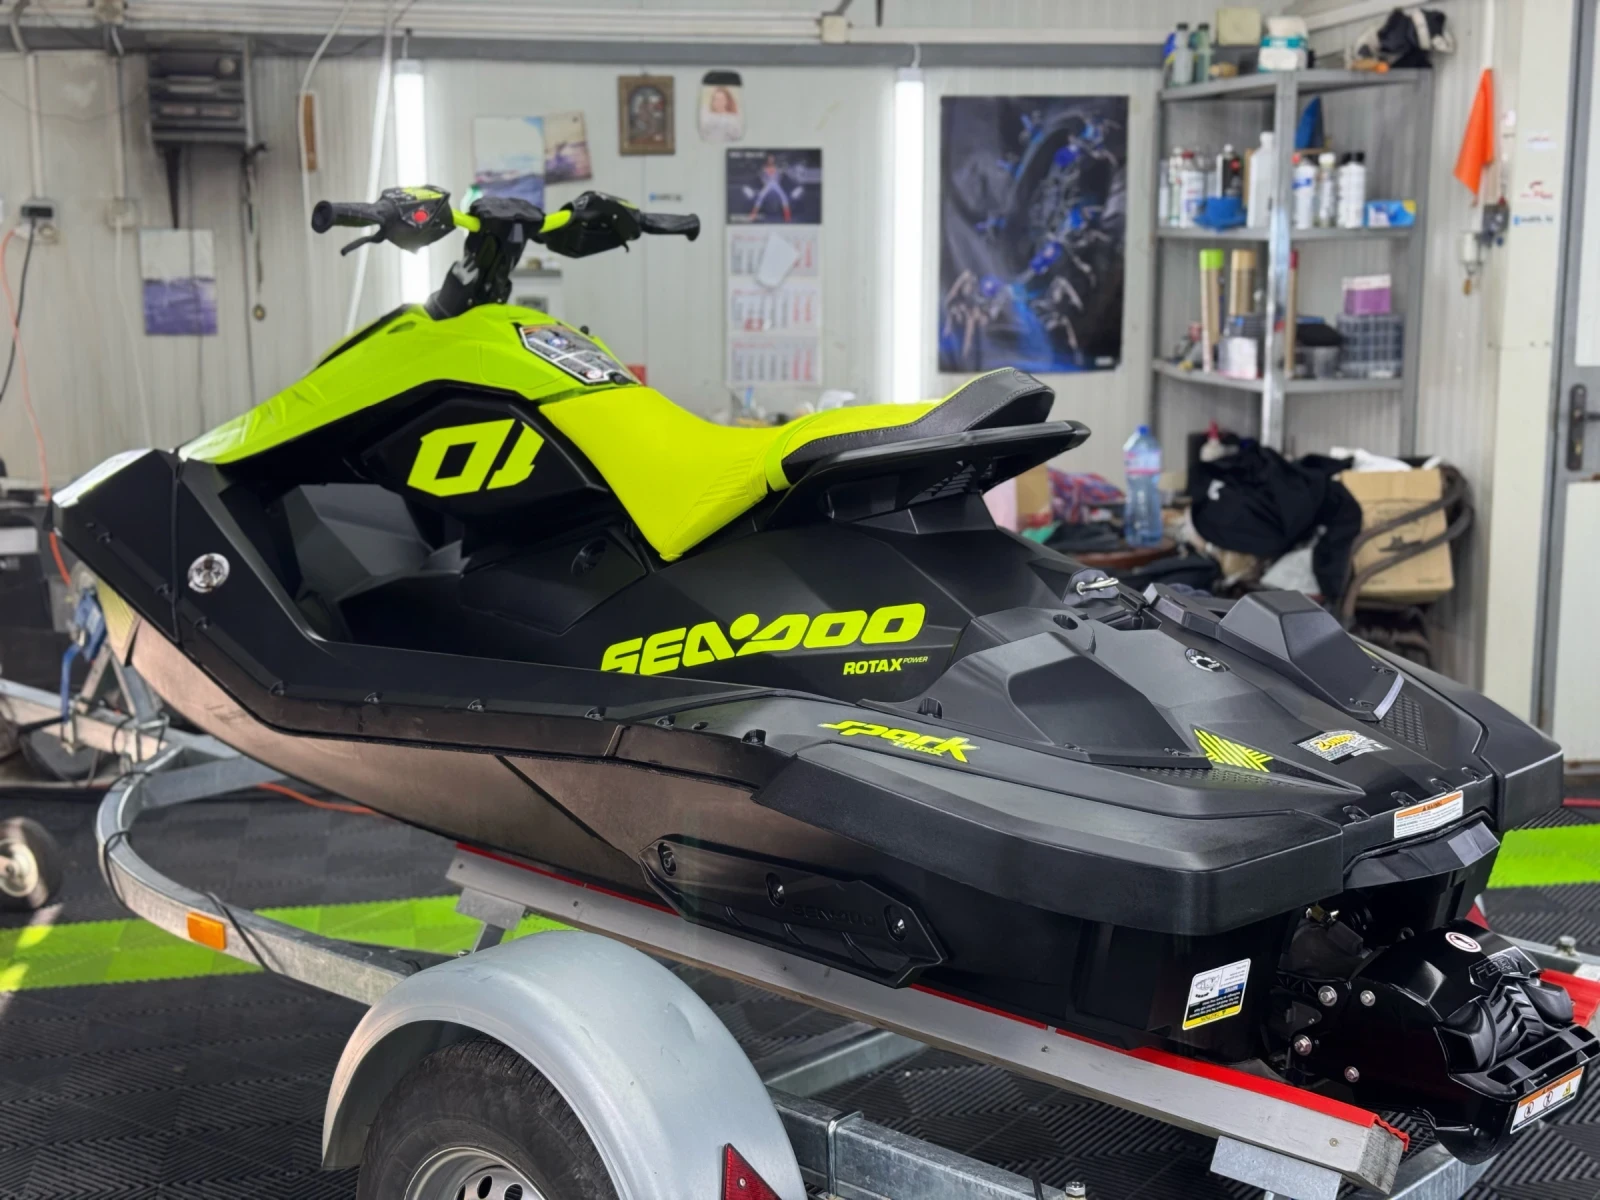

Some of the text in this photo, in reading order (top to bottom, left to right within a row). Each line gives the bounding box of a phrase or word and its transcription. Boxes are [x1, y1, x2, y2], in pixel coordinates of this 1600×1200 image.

[407, 418, 545, 498] 01
[842, 655, 929, 676] ROTAX POWER
